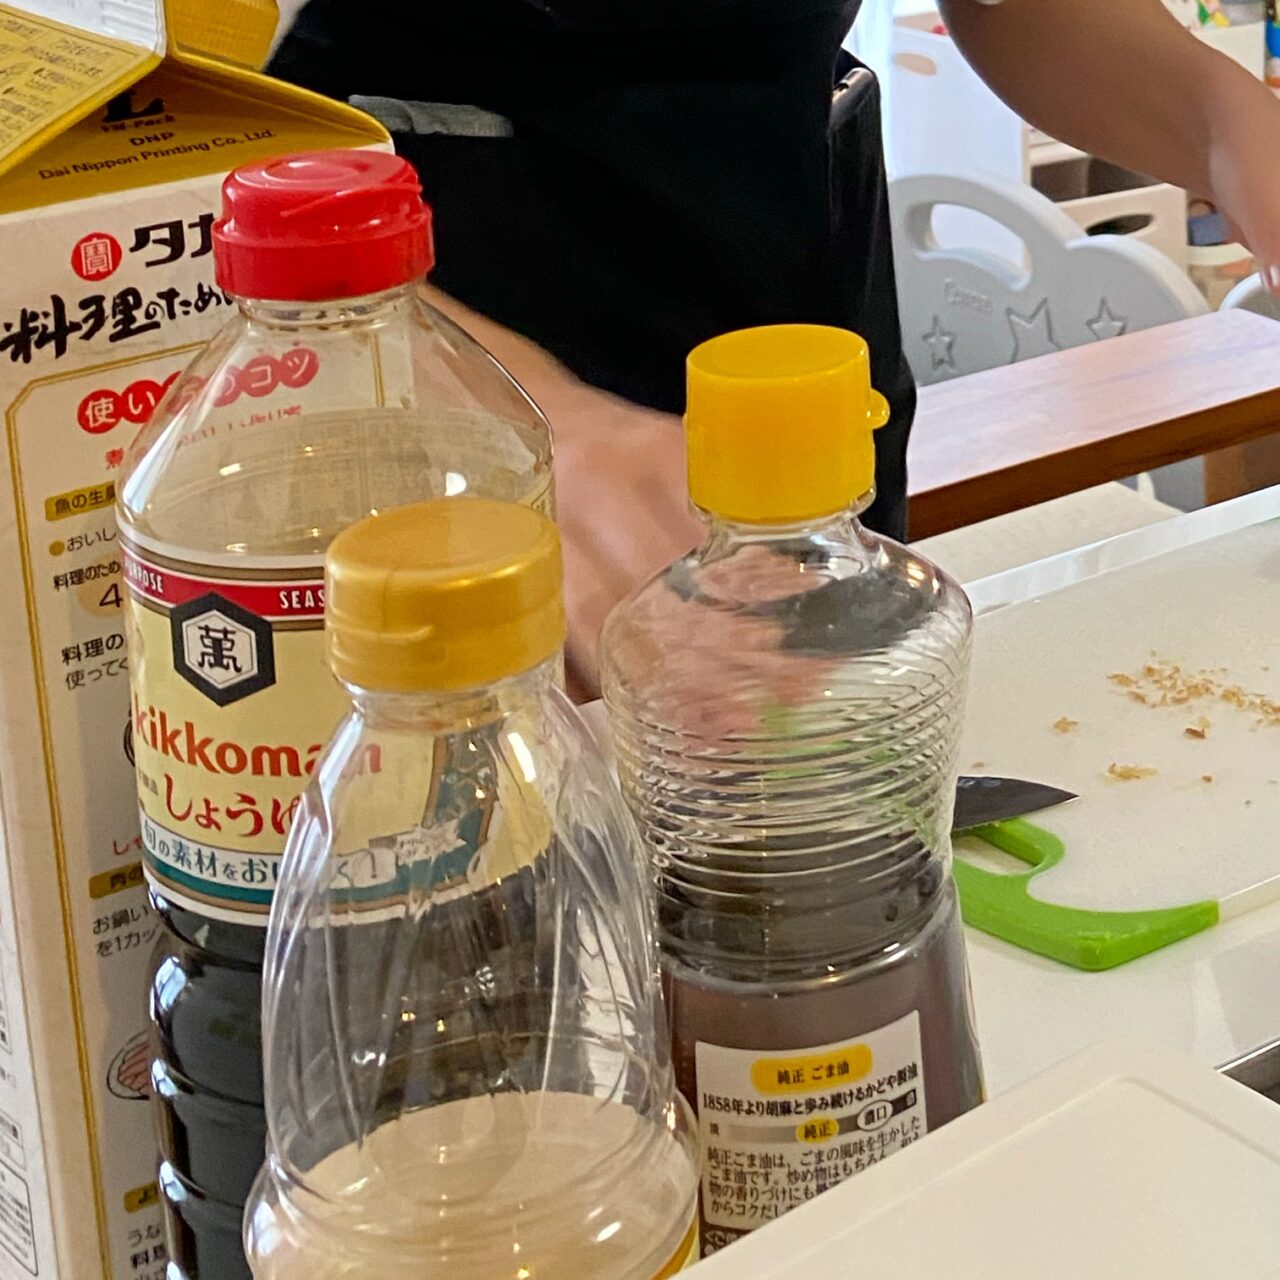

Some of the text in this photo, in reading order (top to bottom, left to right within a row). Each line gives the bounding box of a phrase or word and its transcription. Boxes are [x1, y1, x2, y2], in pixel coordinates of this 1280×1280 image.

[129, 131, 175, 146] DNP
[39, 166, 70, 179] Dai
[72, 154, 139, 173] Nippon
[141, 139, 210, 160] Printing
[62, 632, 124, 665] 料理の
